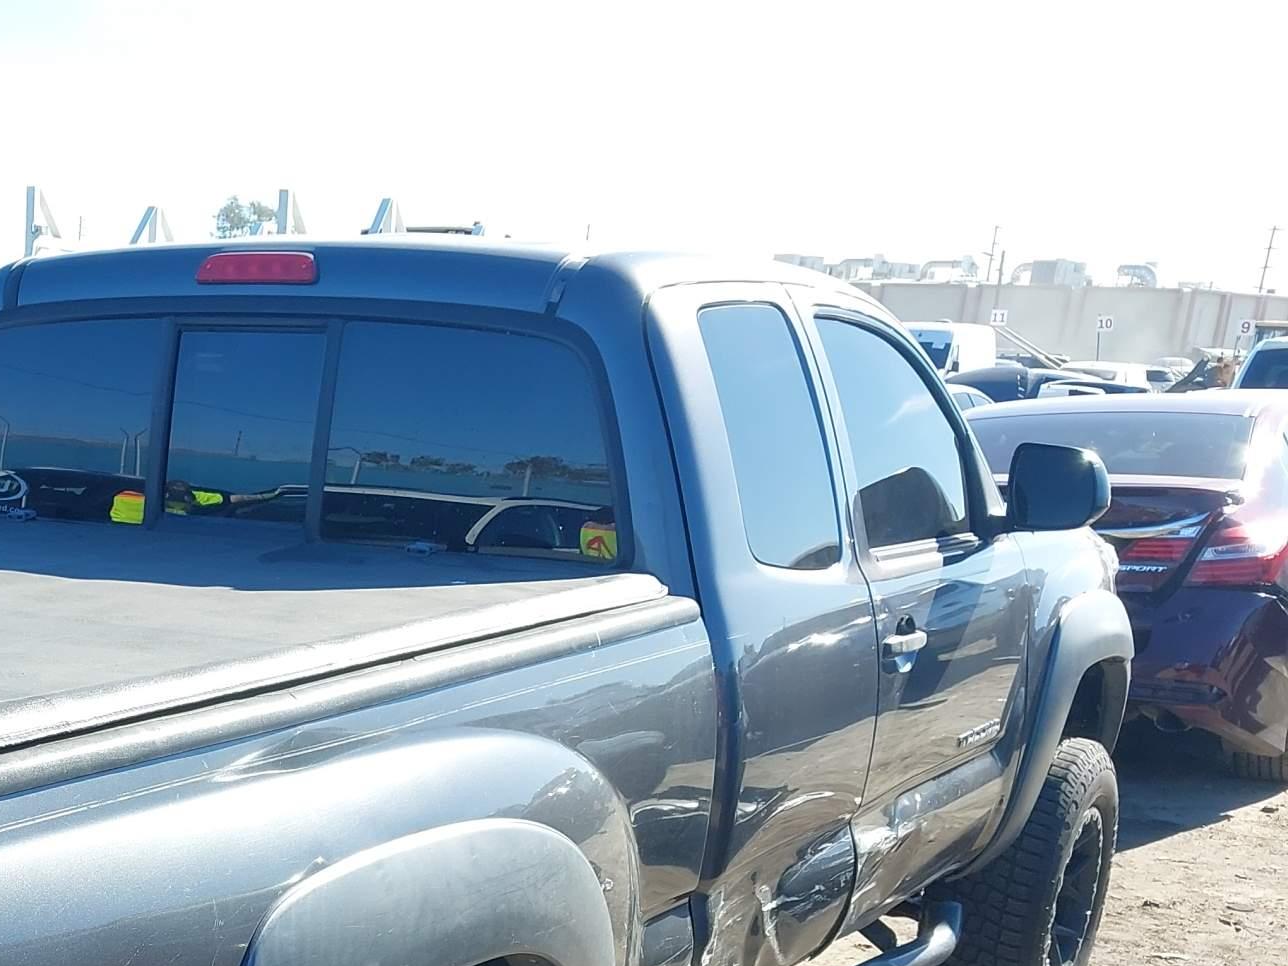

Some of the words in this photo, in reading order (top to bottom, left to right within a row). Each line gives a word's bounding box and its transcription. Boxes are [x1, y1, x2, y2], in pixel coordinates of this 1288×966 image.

[993, 312, 1005, 323] 11
[1099, 319, 1112, 329] 10
[1241, 321, 1251, 334] 9
